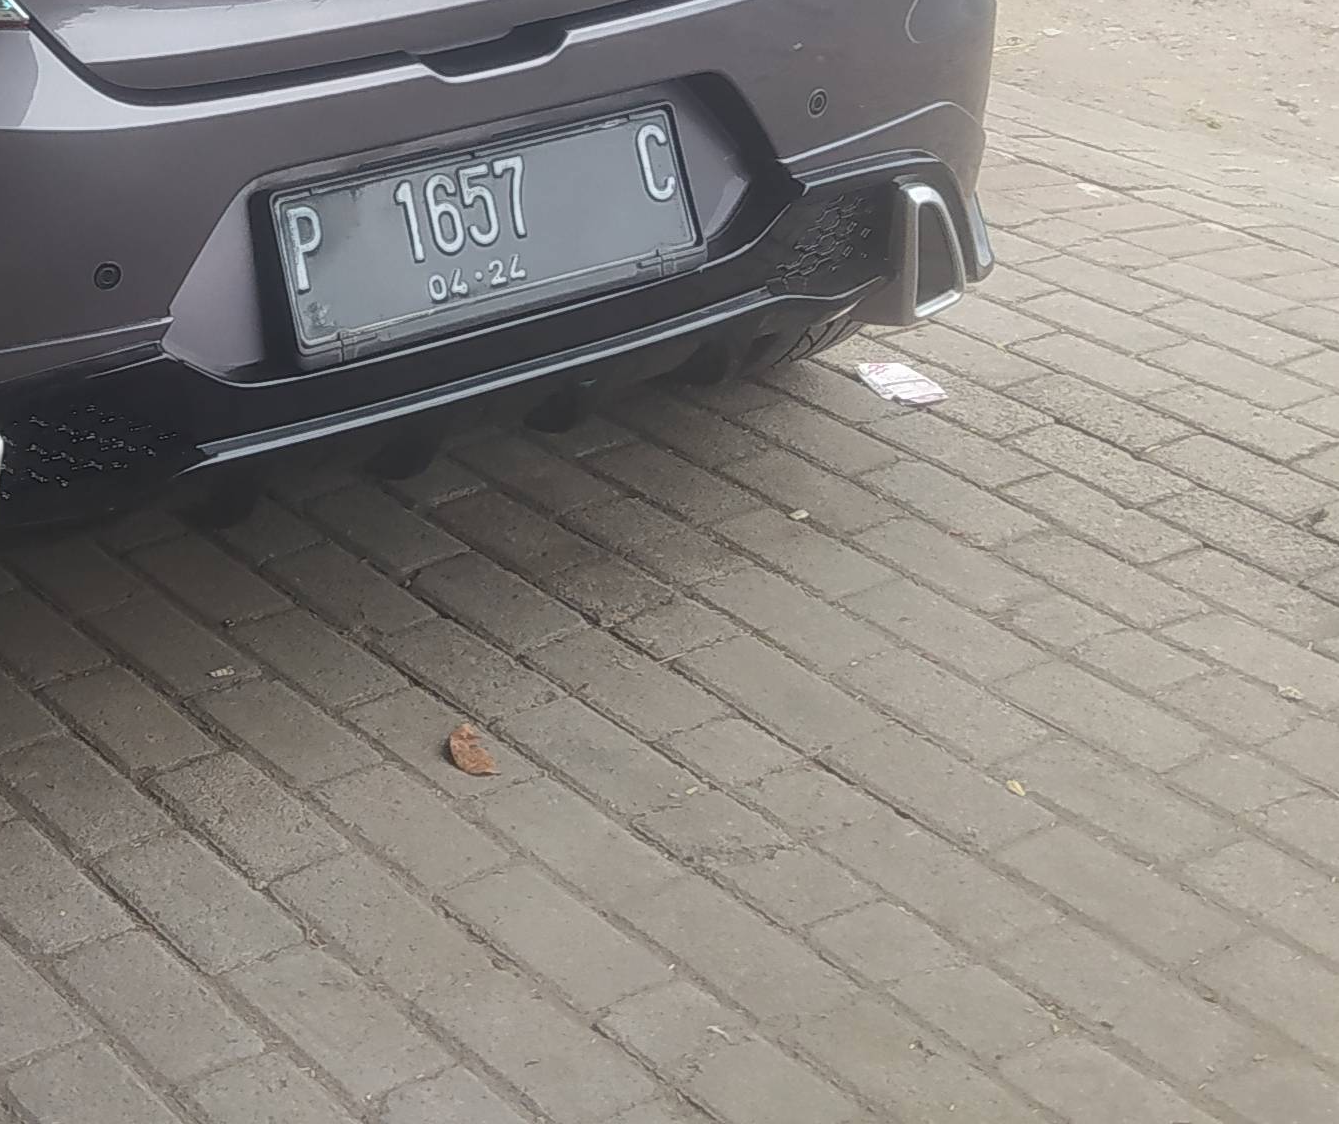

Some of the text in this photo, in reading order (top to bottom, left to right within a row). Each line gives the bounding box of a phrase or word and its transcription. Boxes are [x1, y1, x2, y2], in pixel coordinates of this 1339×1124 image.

[286, 123, 676, 291] P 1657 C
